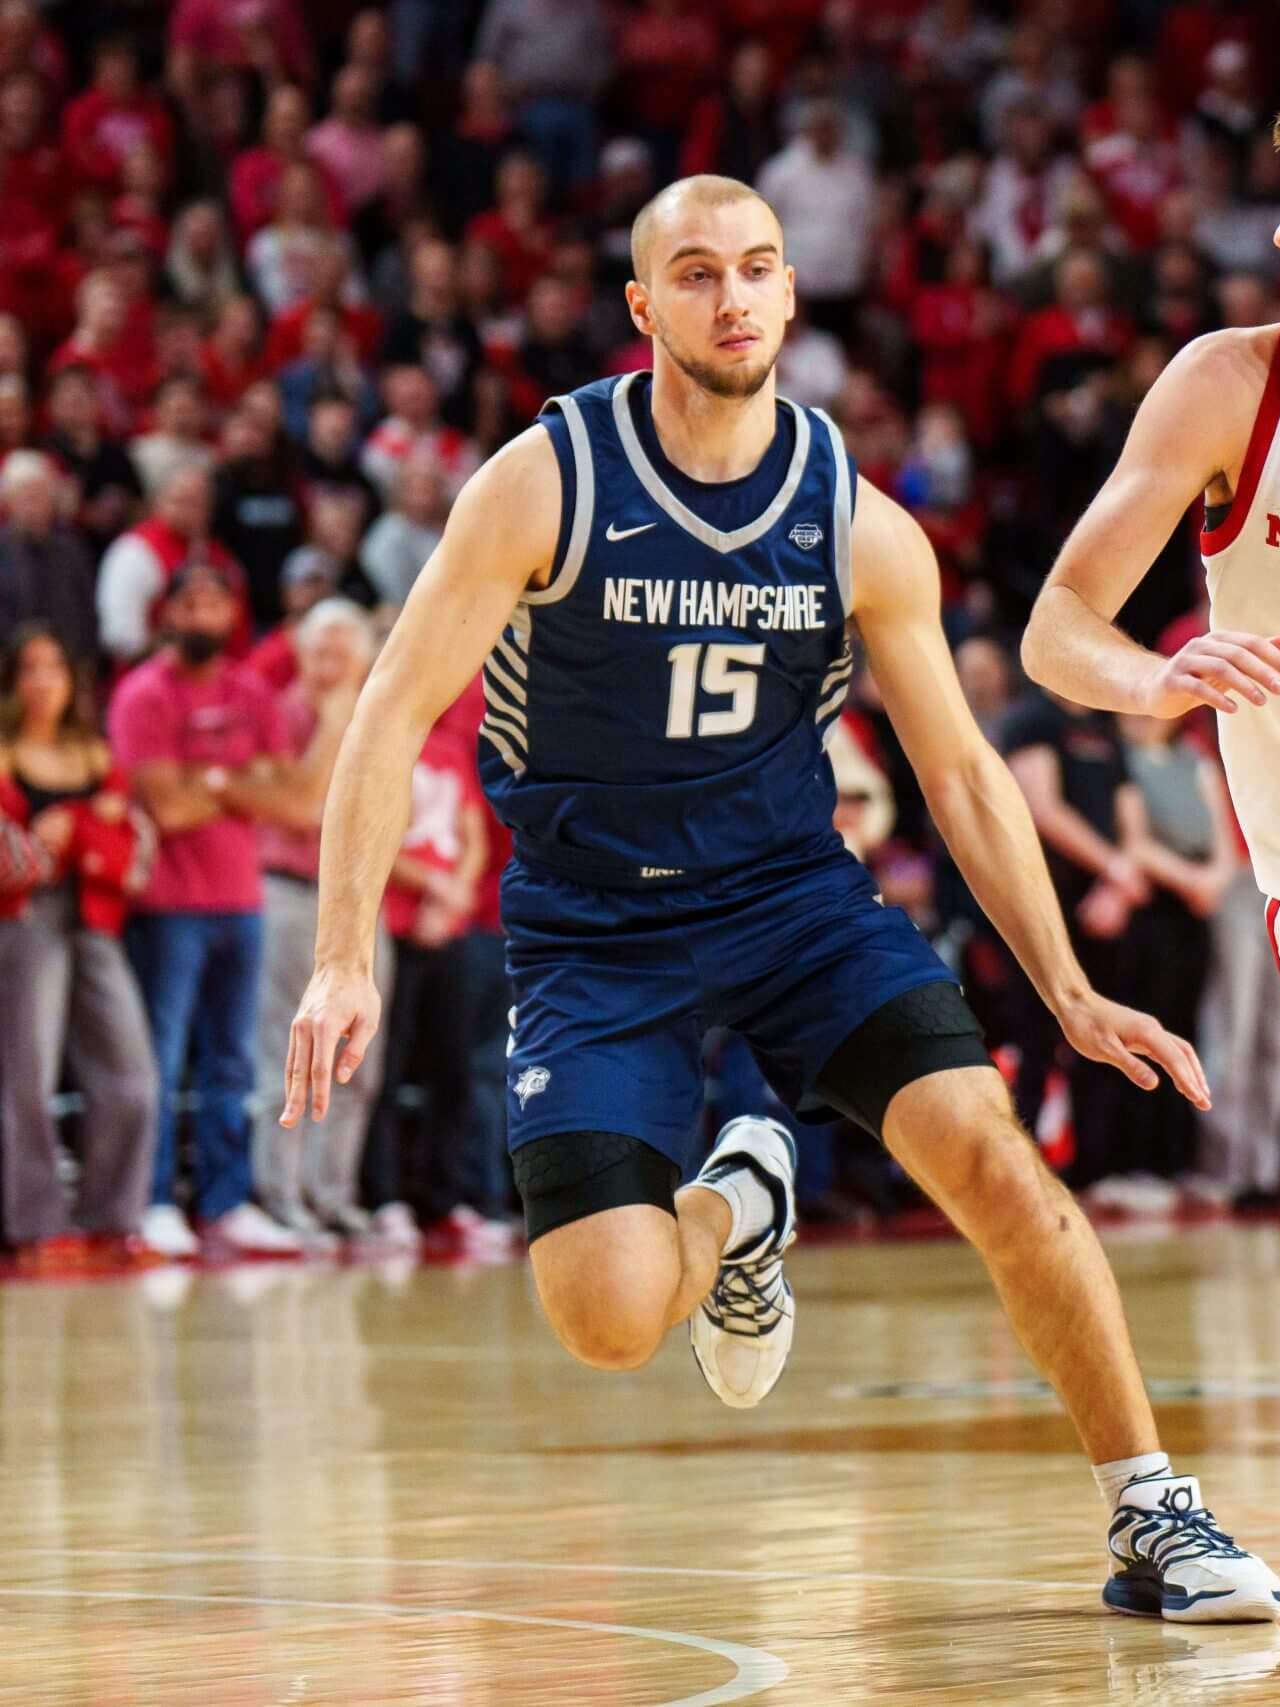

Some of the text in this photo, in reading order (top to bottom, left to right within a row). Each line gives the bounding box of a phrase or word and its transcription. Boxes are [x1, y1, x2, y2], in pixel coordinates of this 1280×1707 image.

[603, 577, 827, 631] NEW HAMPSHIRE
[665, 643, 767, 739] 15
